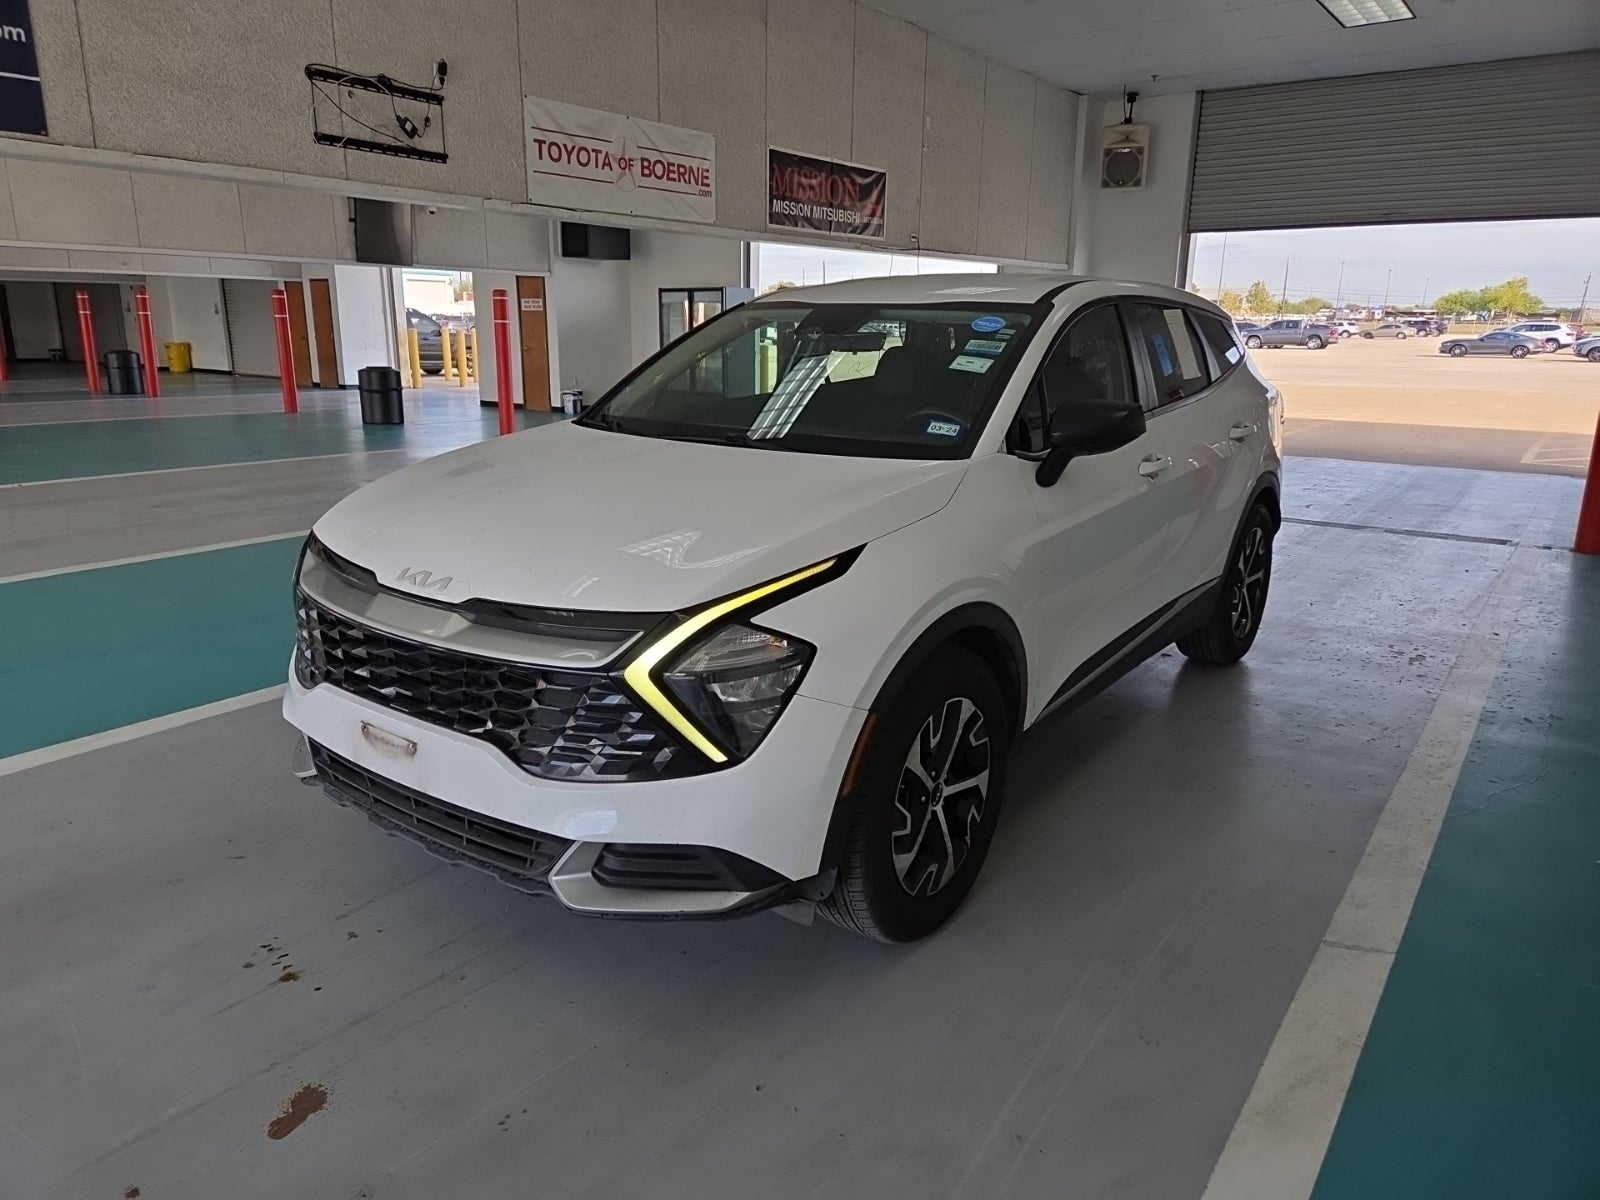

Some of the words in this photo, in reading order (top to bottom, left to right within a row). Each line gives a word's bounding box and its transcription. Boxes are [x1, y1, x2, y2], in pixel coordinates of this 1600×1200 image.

[533, 138, 613, 172] TOYOTA
[618, 156, 634, 171] OF
[640, 157, 711, 188] BOERNE
[772, 166, 860, 207] MISSION
[772, 198, 811, 218] MISSION
[812, 205, 861, 225] MITSUBISHI
